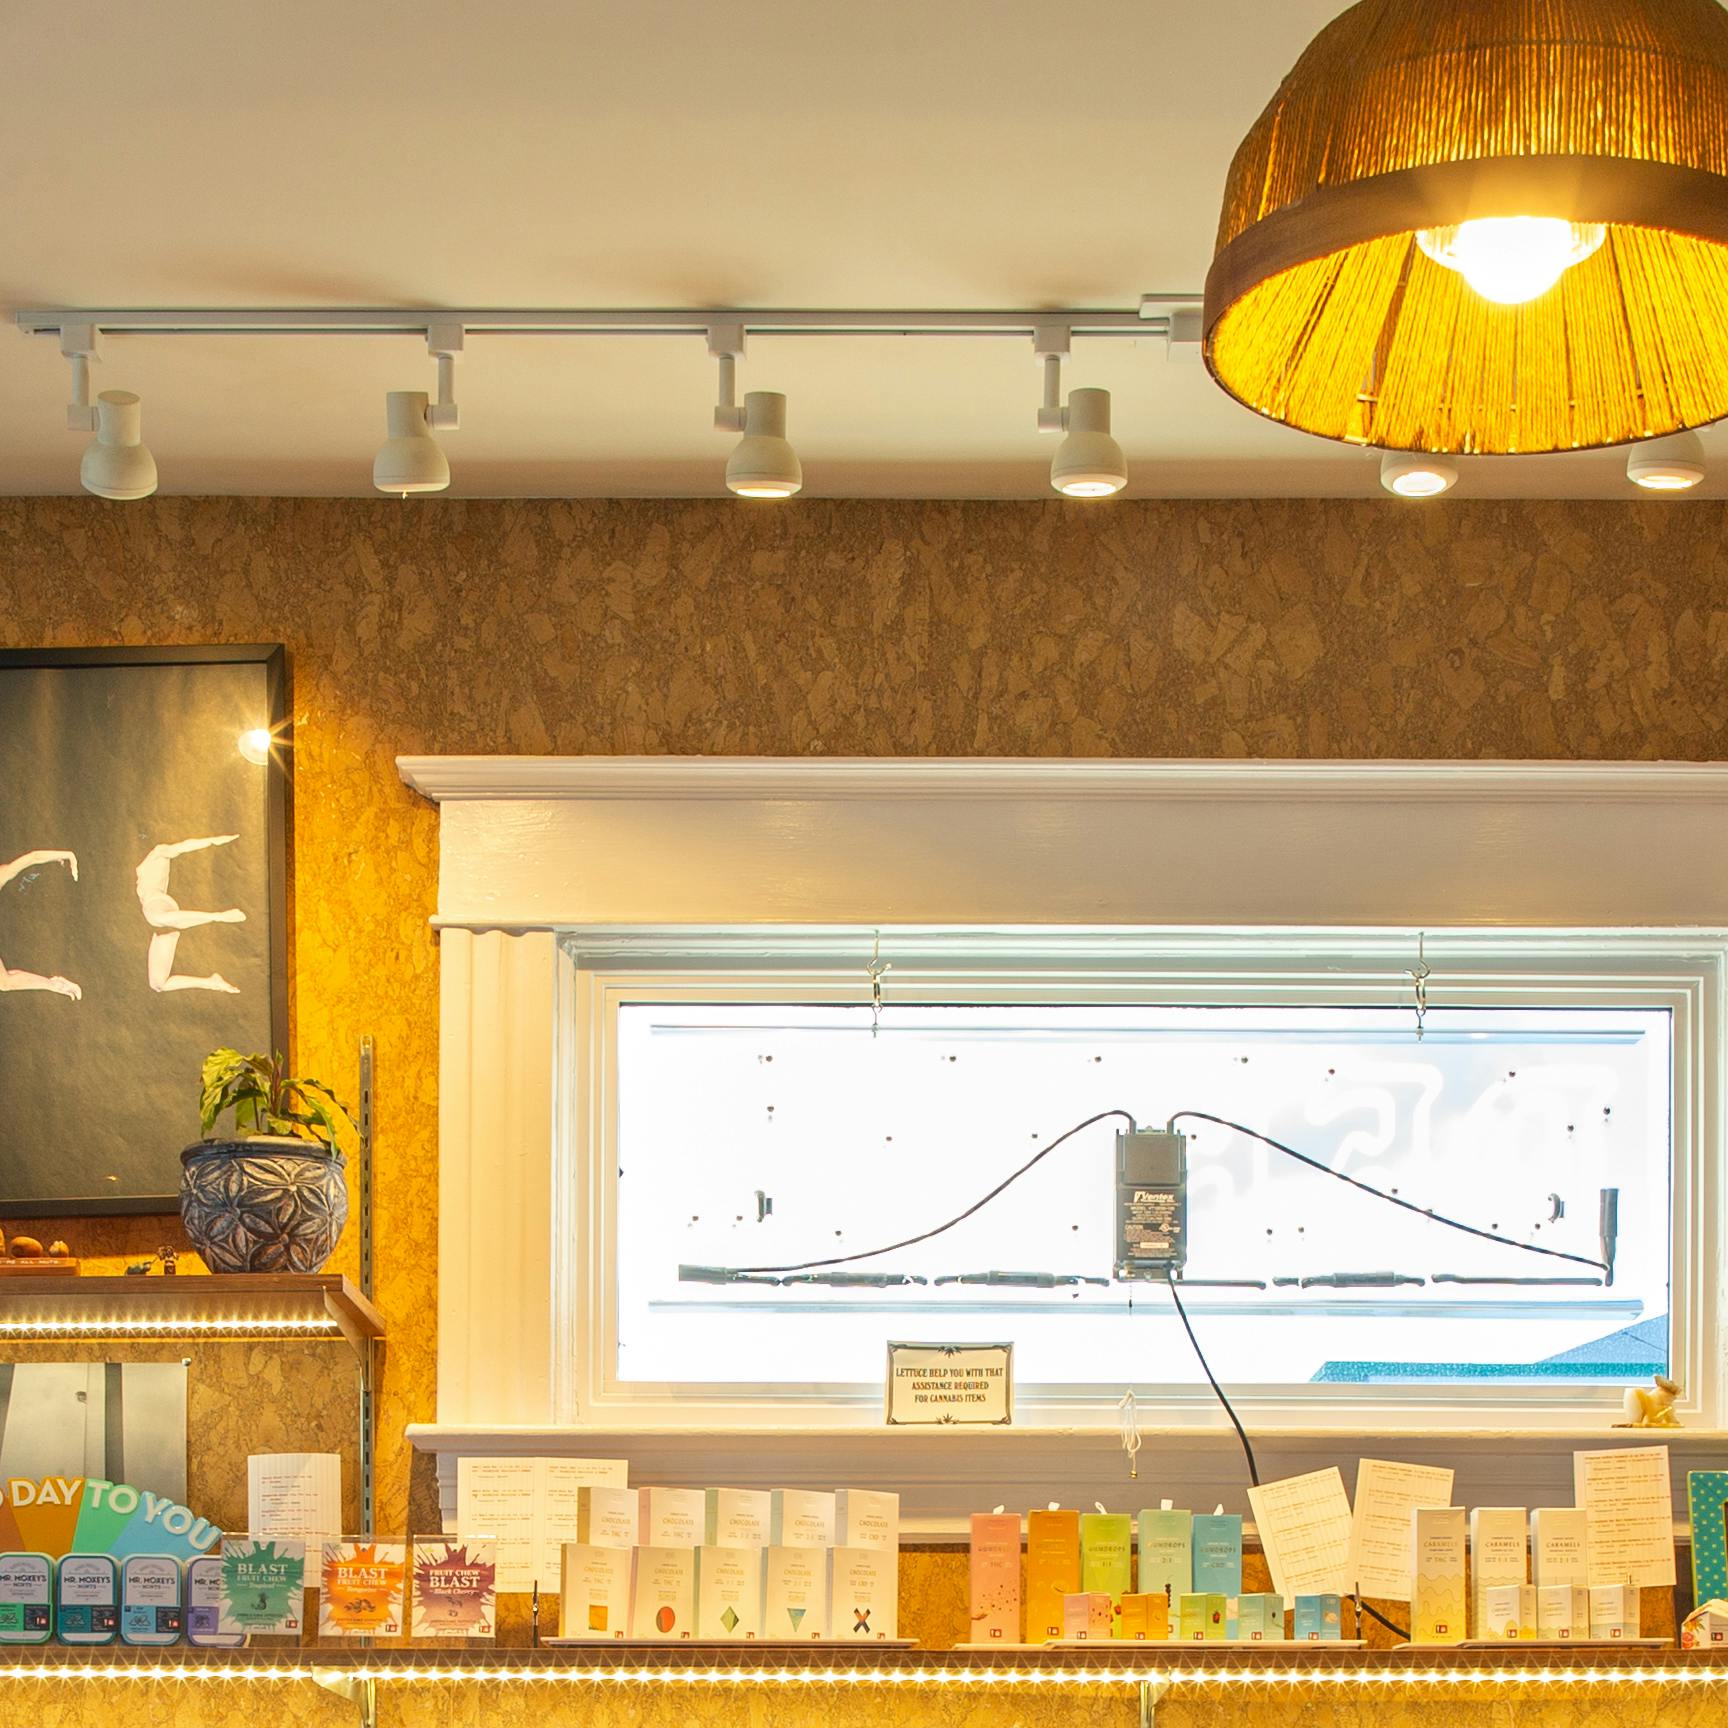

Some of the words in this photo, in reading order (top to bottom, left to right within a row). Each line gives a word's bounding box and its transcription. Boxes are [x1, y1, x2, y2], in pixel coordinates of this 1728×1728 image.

[896, 1368, 928, 1377] LETTUCE
[929, 1368, 948, 1377] HELP
[950, 1368, 964, 1377] YOU
[966, 1368, 983, 1377] WITH
[985, 1368, 1003, 1377] THAT
[912, 1382, 952, 1390] ASSISTANCE
[954, 1381, 989, 1391] REQUIRED
[915, 1395, 928, 1403] FOR
[930, 1394, 963, 1403] CANNABIS
[965, 1394, 986, 1402] ITEMS
[11, 1477, 84, 1507] DAY
[86, 1479, 139, 1514] TO
[140, 1491, 223, 1553] YOU
[237, 1563, 288, 1574] BLAST
[338, 1567, 388, 1578] BLAST
[429, 1577, 480, 1588] BLAST
